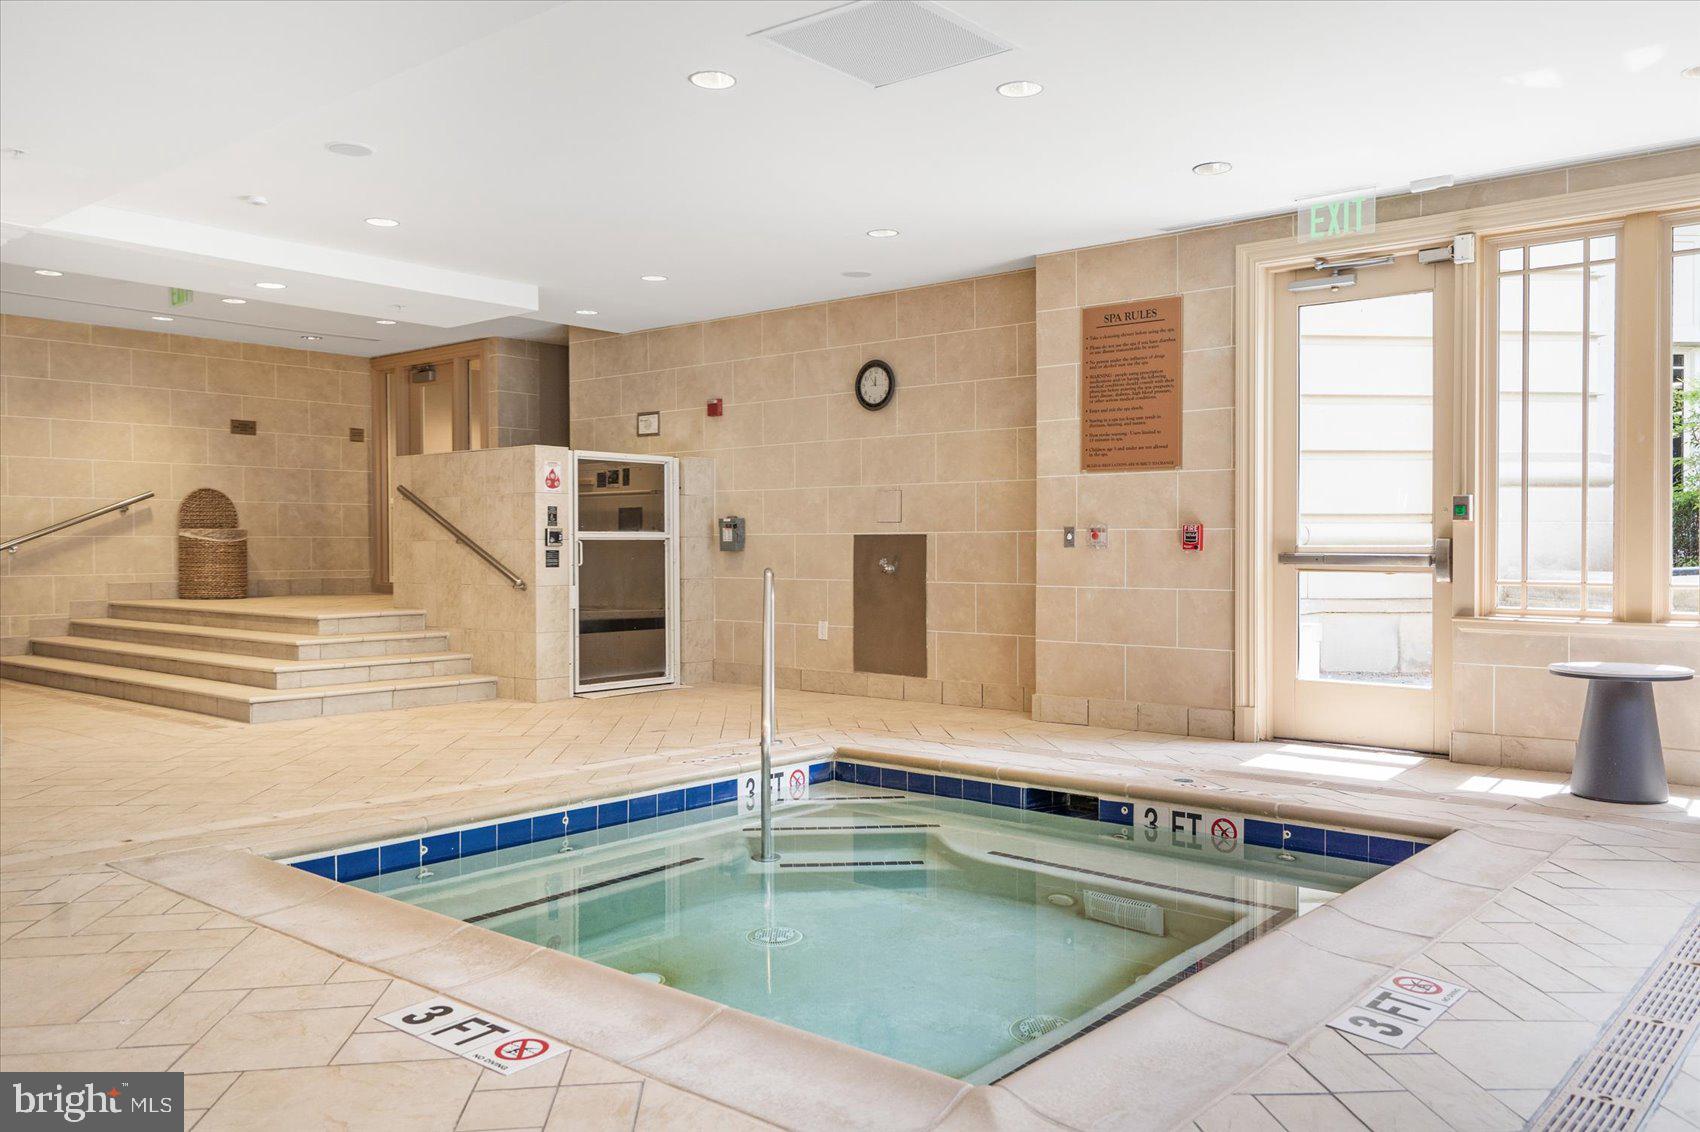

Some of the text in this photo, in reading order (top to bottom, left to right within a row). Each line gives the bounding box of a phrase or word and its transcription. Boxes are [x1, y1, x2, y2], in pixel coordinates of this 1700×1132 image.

[1310, 197, 1365, 240] EXIT
[1104, 308, 1157, 324] SPA RULES
[746, 778, 755, 798] 3
[1144, 807, 1202, 836] 3 FT
[402, 1005, 510, 1046] 3 FT
[1348, 991, 1431, 1037] 3 FT
